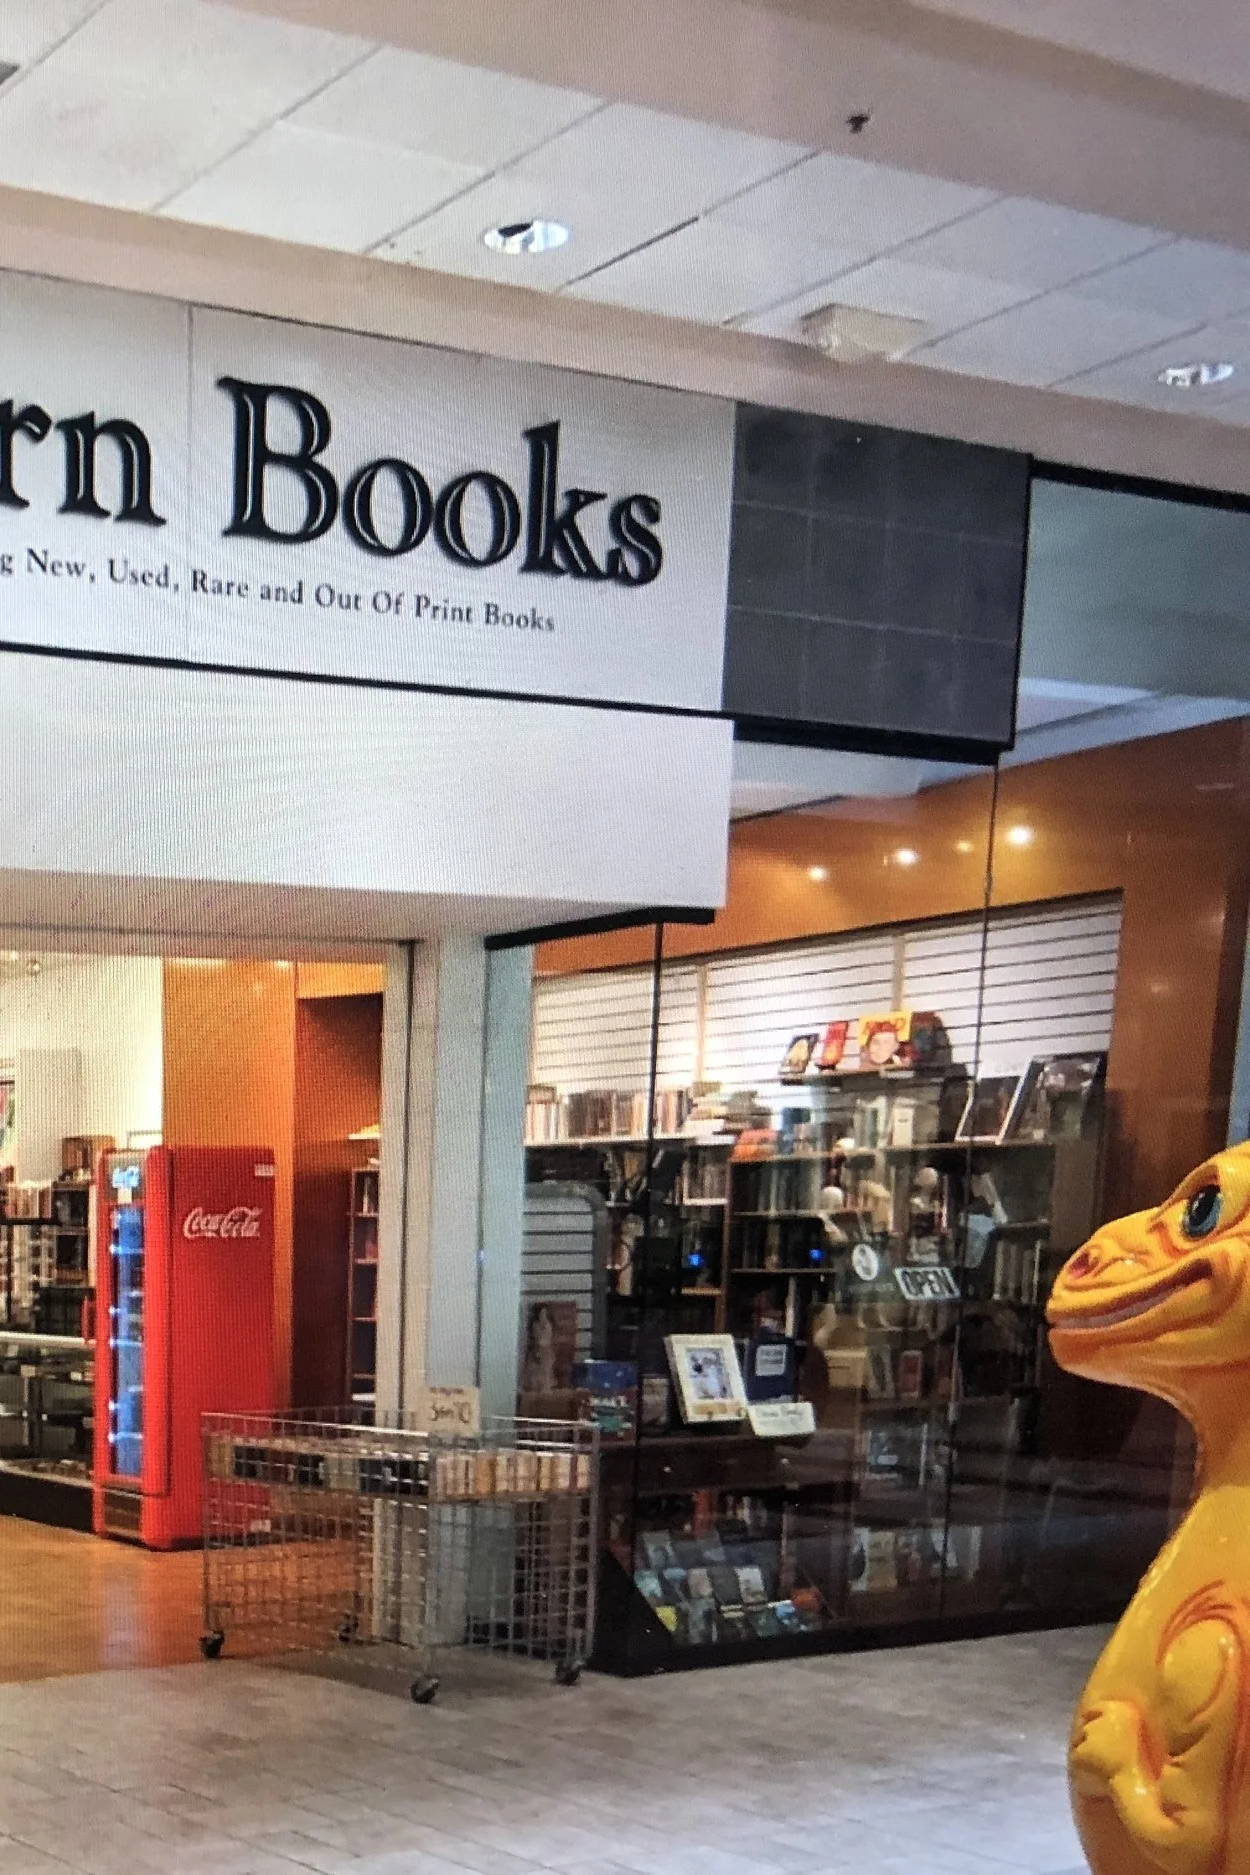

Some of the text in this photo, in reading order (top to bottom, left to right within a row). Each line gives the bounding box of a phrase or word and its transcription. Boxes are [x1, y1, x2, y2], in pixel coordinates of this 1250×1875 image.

[216, 376, 663, 586] Books
[26, 547, 96, 584] New,
[107, 557, 180, 592] Used,
[191, 567, 250, 599] Rare
[260, 578, 304, 604] and
[314, 582, 362, 611] Out
[372, 589, 405, 616] Of
[414, 593, 474, 625] Print
[484, 601, 556, 633] Books
[183, 1206, 264, 1240] Coca-Cola
[900, 1269, 956, 1299] OPEN
